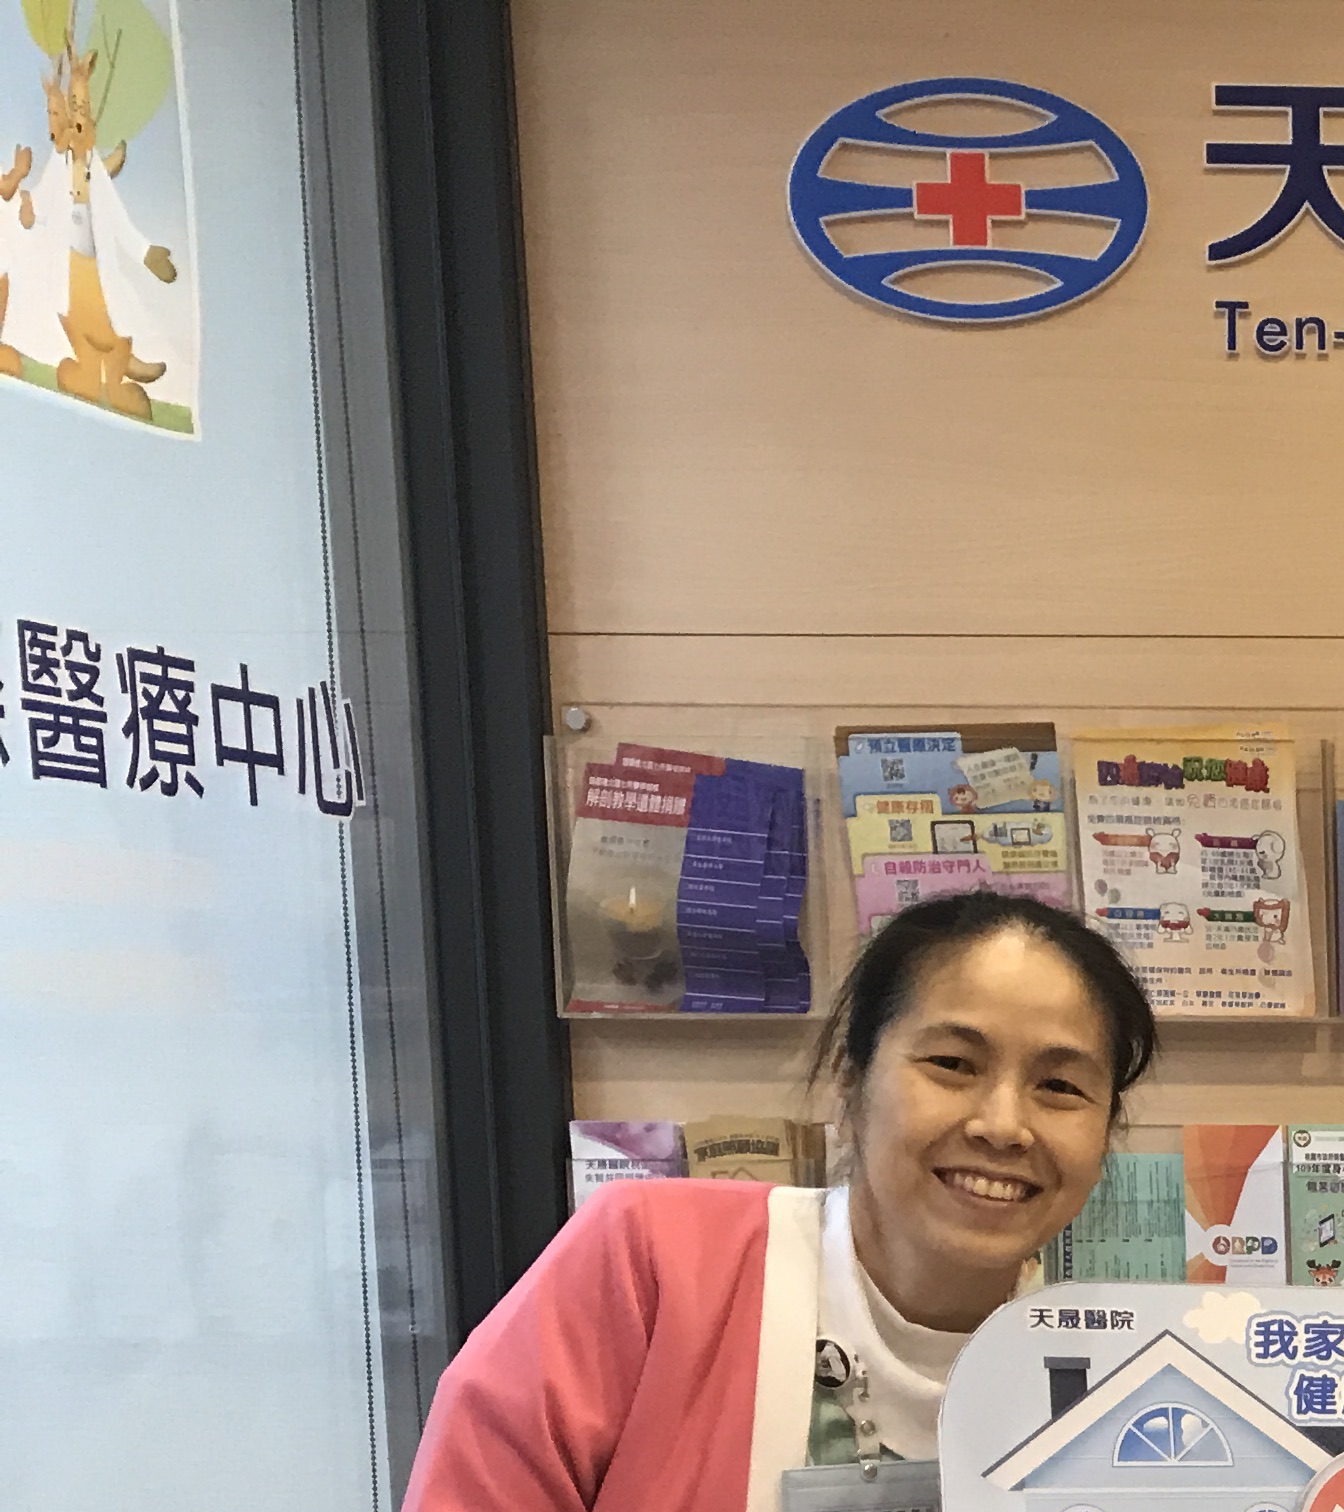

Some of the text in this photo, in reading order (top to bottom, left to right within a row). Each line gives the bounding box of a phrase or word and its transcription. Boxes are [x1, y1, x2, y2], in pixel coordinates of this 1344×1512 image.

[0, 617, 365, 817] 醫療中心
[1028, 1308, 1135, 1332] 天晟醫院
